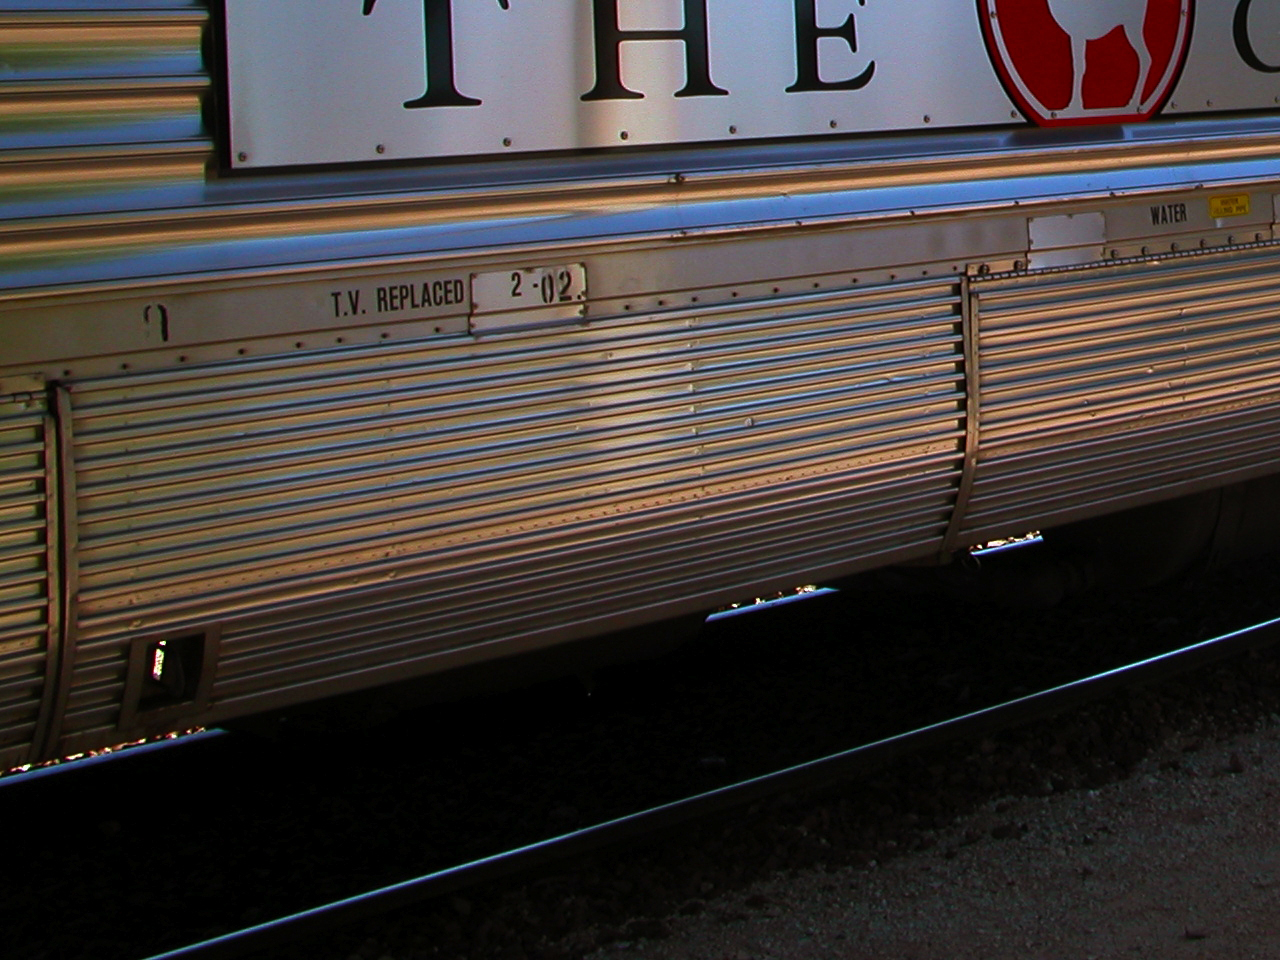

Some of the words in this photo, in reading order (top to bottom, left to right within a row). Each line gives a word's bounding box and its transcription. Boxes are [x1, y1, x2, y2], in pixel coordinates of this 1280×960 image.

[1150, 203, 1187, 225] WATER
[331, 289, 367, 318] T.V.
[376, 279, 465, 313] REPLACED
